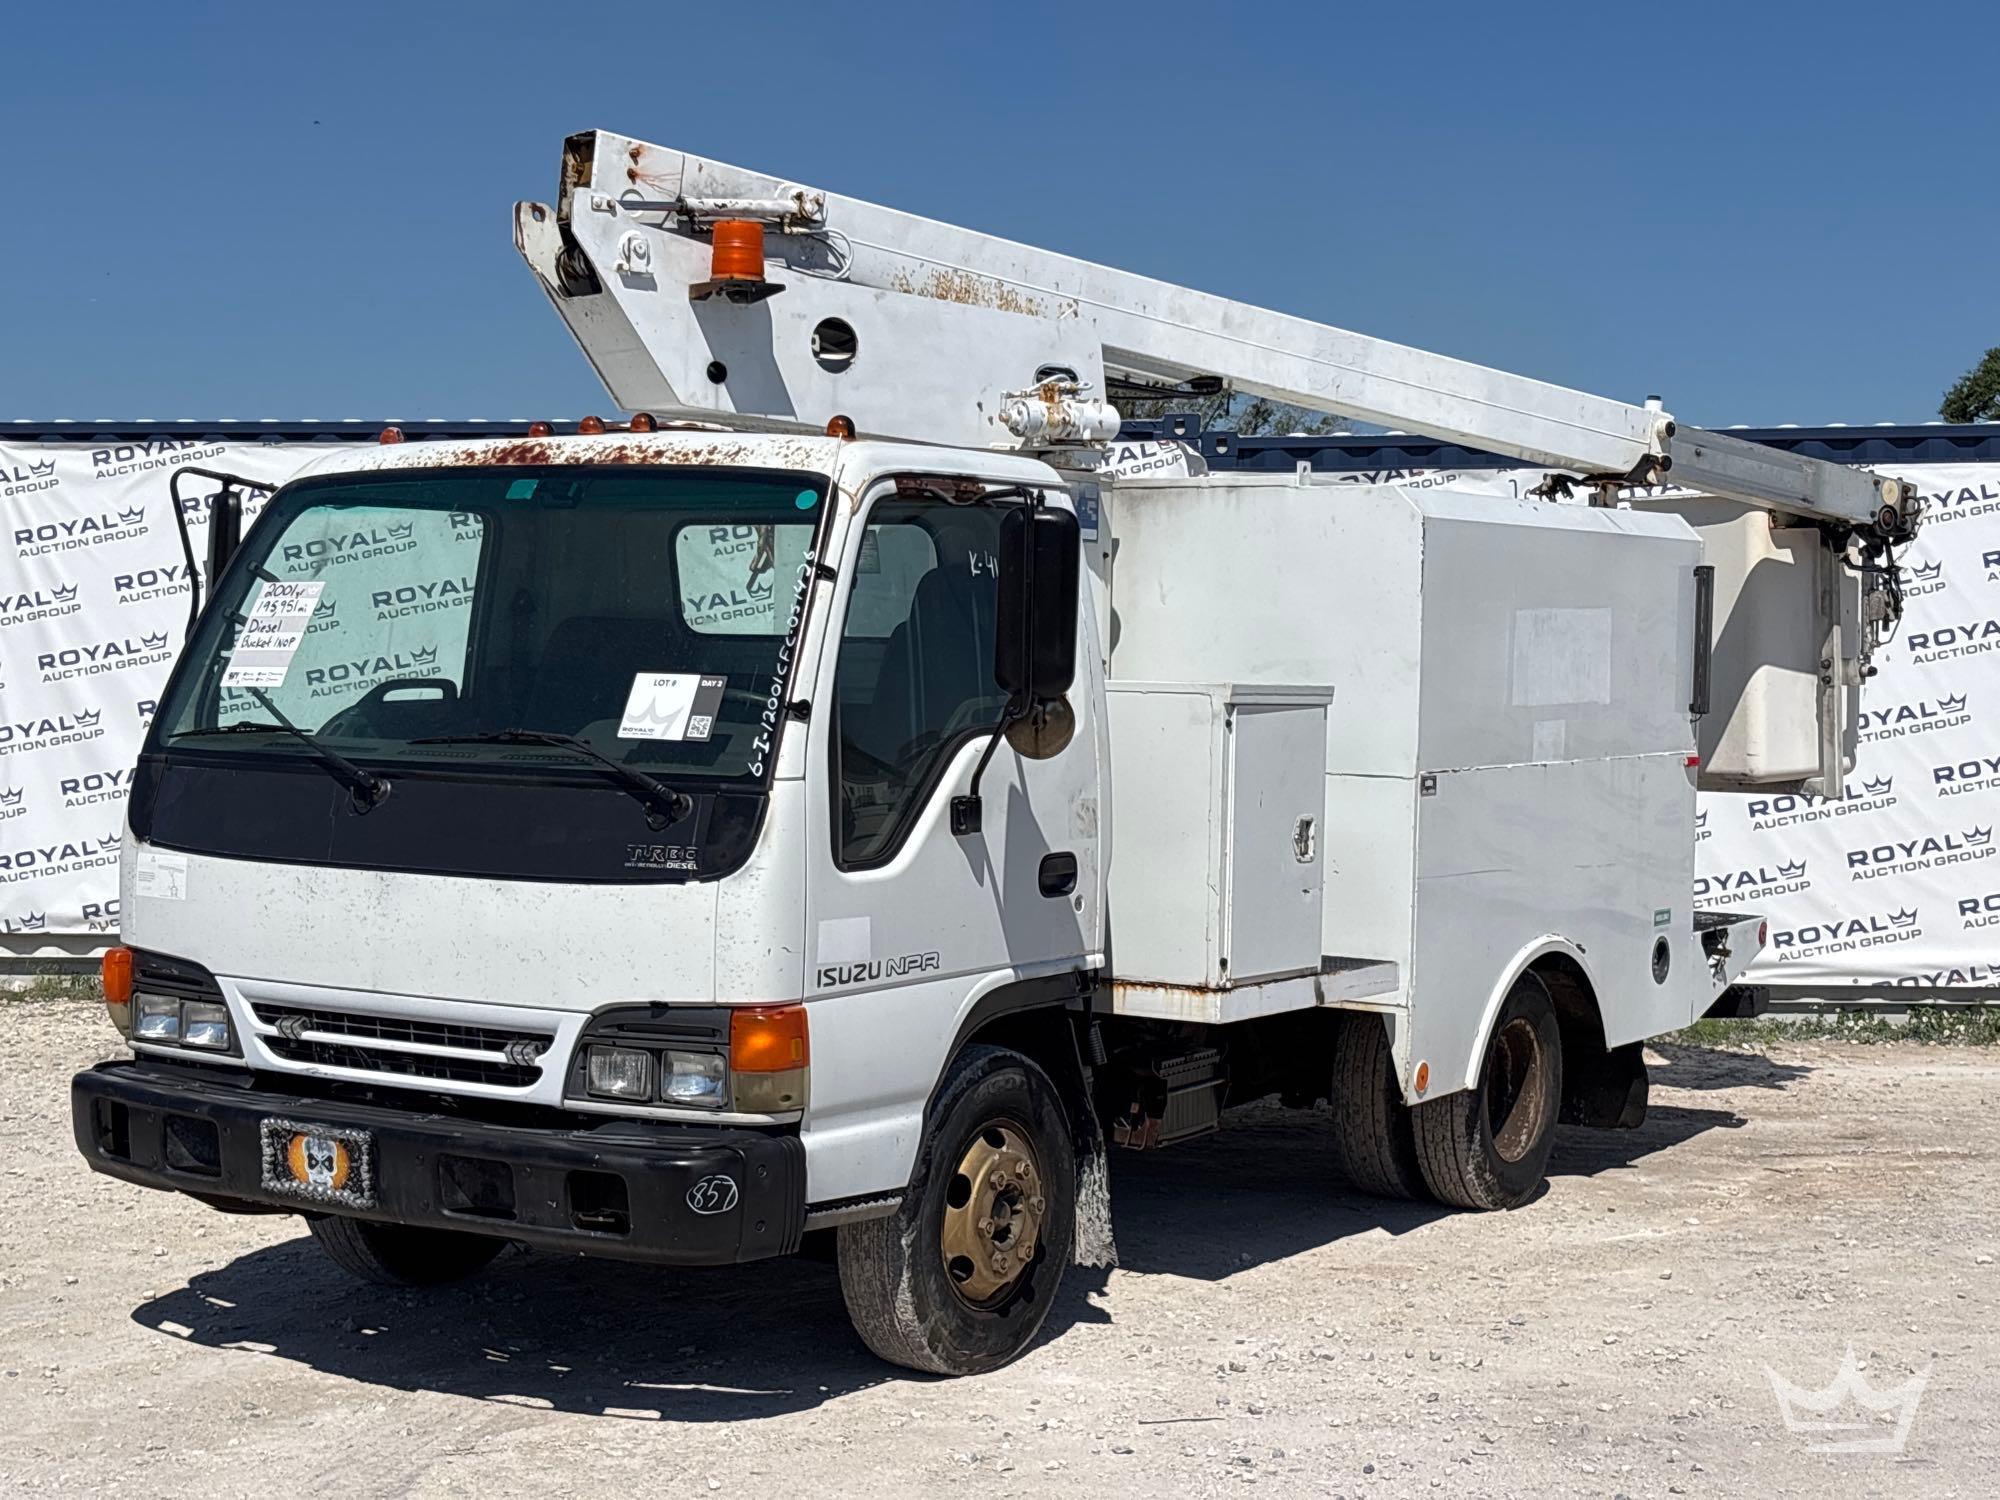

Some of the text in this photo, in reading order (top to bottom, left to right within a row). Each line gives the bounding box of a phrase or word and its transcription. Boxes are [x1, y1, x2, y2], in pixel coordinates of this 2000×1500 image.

[95, 446, 226, 479] AUCTION GROUP
[1130, 453, 1183, 474] GROUP
[4, 478, 60, 497] GROUP
[15, 513, 119, 545] ROYAL
[18, 526, 149, 558] AUCTION GROUP
[283, 529, 387, 561] ROYAL
[287, 541, 418, 574] AUCTION GROUP
[118, 582, 190, 605] AUCTION
[372, 577, 475, 608] ROYAL
[27, 603, 82, 621] GROUP
[248, 618, 283, 634] Diesel
[377, 599, 449, 621] AUCTION
[38, 639, 142, 671] ROYAL
[241, 635, 272, 649] Bucket
[1912, 641, 1992, 665] AUCTION
[42, 651, 173, 683] AUCTION GROUP
[305, 653, 412, 685] ROYAL
[653, 679, 670, 687] LOT
[50, 728, 105, 746] GROUP
[1909, 714, 1972, 734] GROUP
[1752, 797, 1897, 832] AUCTION GROUP
[666, 862, 699, 870] DIESEL
[1846, 834, 1964, 868] ROYAL
[1851, 847, 1997, 882] AUCTION GROUP
[1748, 880, 1811, 900] GROUP
[1772, 916, 1889, 949] ROYAL
[1778, 929, 1922, 962] AUCTION GROUP
[816, 951, 940, 989] ISUZU NPR
[692, 1179, 736, 1211] 857
